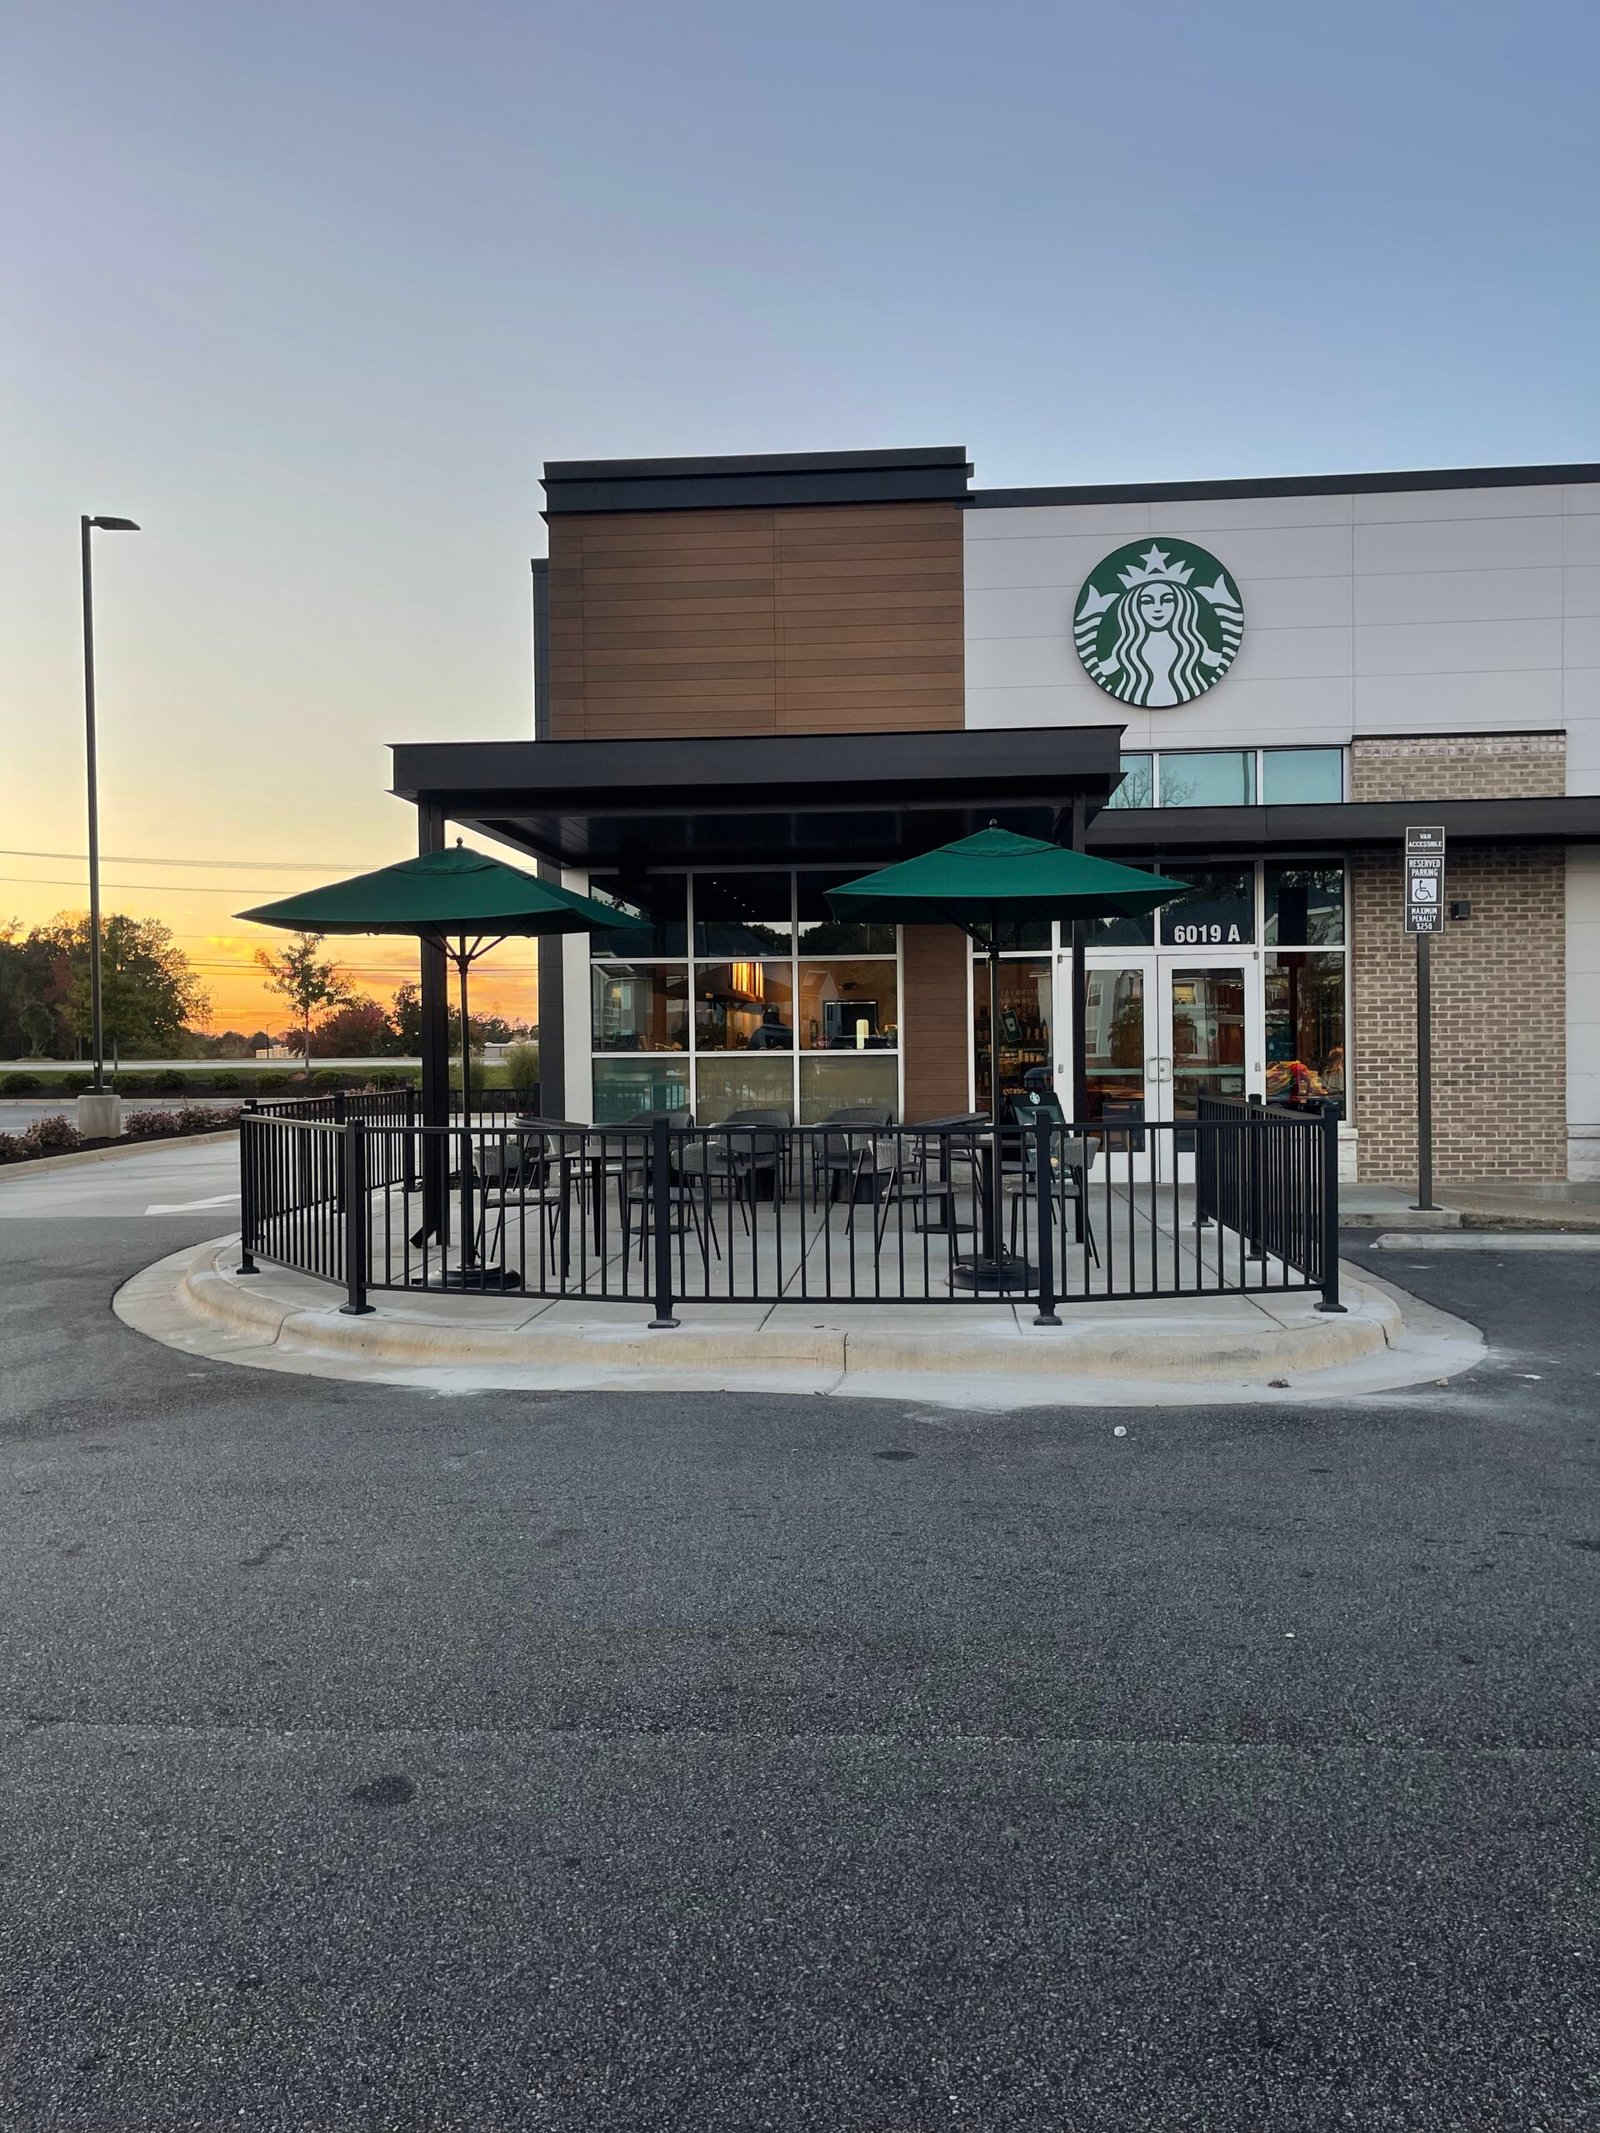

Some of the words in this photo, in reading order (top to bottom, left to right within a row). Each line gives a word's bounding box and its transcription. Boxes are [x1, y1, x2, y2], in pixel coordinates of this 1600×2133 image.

[1408, 840, 1442, 848] ACCESSIBLE
[1408, 859, 1441, 868] RESERVED
[1411, 868, 1439, 877] PARKING
[1411, 907, 1438, 915] MAXIMUM
[1411, 915, 1437, 923] PENALTY
[1174, 924, 1222, 943] 6019
[1227, 924, 1241, 942] A
